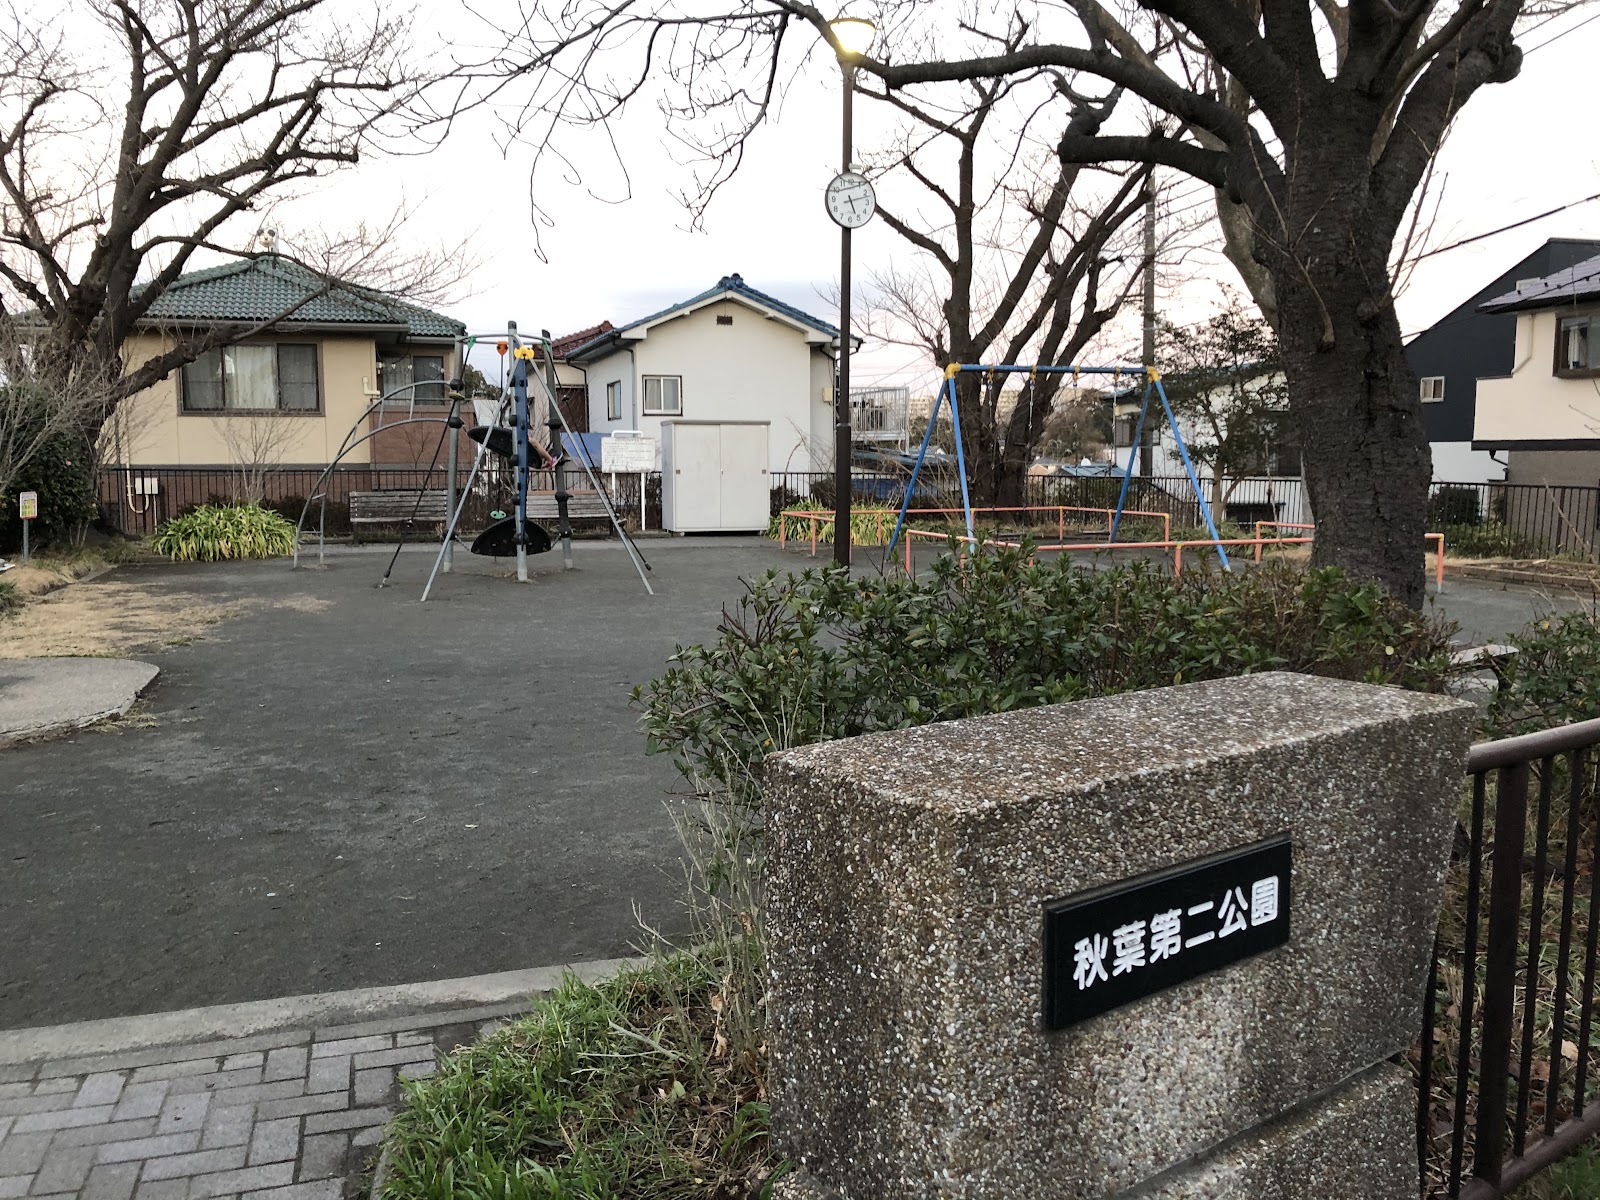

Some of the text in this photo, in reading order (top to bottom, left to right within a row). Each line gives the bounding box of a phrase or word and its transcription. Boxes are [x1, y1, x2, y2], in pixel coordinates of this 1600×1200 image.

[858, 181, 861, 189] 1
[1072, 875, 1279, 991] 秋葉第二公園
